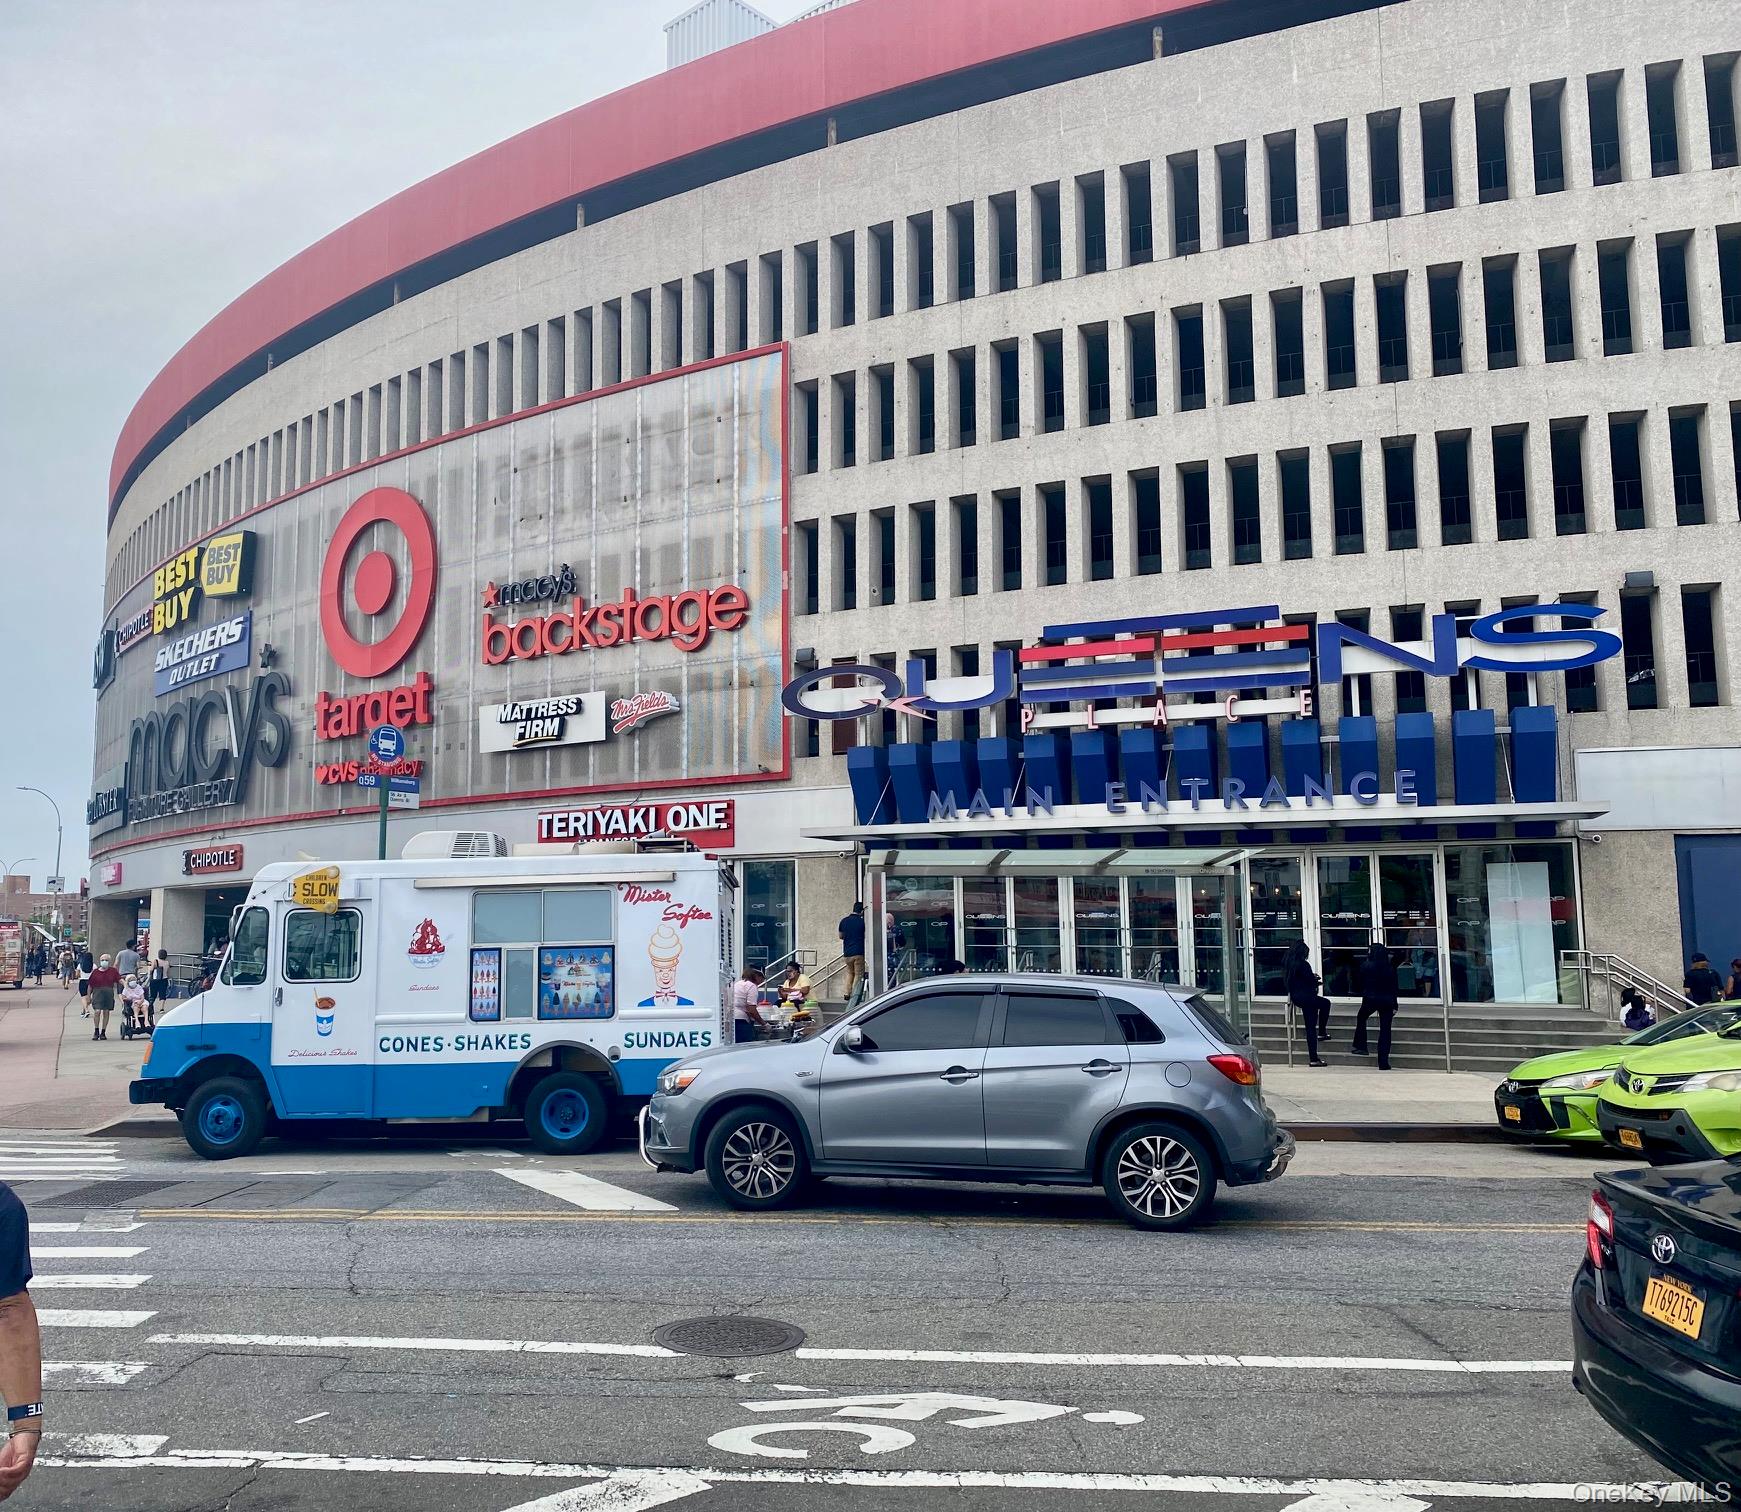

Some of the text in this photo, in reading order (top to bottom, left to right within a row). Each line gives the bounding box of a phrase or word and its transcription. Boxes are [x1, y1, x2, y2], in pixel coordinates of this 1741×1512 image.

[206, 543, 240, 565] BEST
[154, 547, 198, 600] BEST
[206, 563, 236, 585] BUY
[153, 586, 194, 635] BUY
[119, 613, 149, 645] CHIPOTLE
[482, 584, 749, 665] backstage
[154, 616, 244, 673] SKECHERS
[169, 653, 220, 685] OUTLET
[781, 604, 1622, 720] QUEENS
[315, 672, 434, 741] target
[497, 697, 581, 723] MATTRESS
[1021, 689, 1312, 733] PLACE
[514, 717, 562, 740] FIRM
[328, 760, 359, 784] CVS
[358, 775, 375, 786] Q59
[927, 769, 1418, 820] MAIN ENTRANCE
[538, 803, 728, 838] TERIYAKI ONE
[190, 850, 235, 869] CHIPOTLE
[302, 883, 338, 897] SLOW
[617, 881, 672, 905] Mister
[661, 903, 713, 929] Softee
[1321, 911, 1370, 920] QUEENS
[408, 984, 440, 992] Sundaes
[288, 1048, 358, 1058] Delicious Shakes
[379, 1033, 532, 1053] CONES SHAKES
[623, 1031, 713, 1049] SUNDAES
[1650, 1281, 1698, 1326] T769215C
